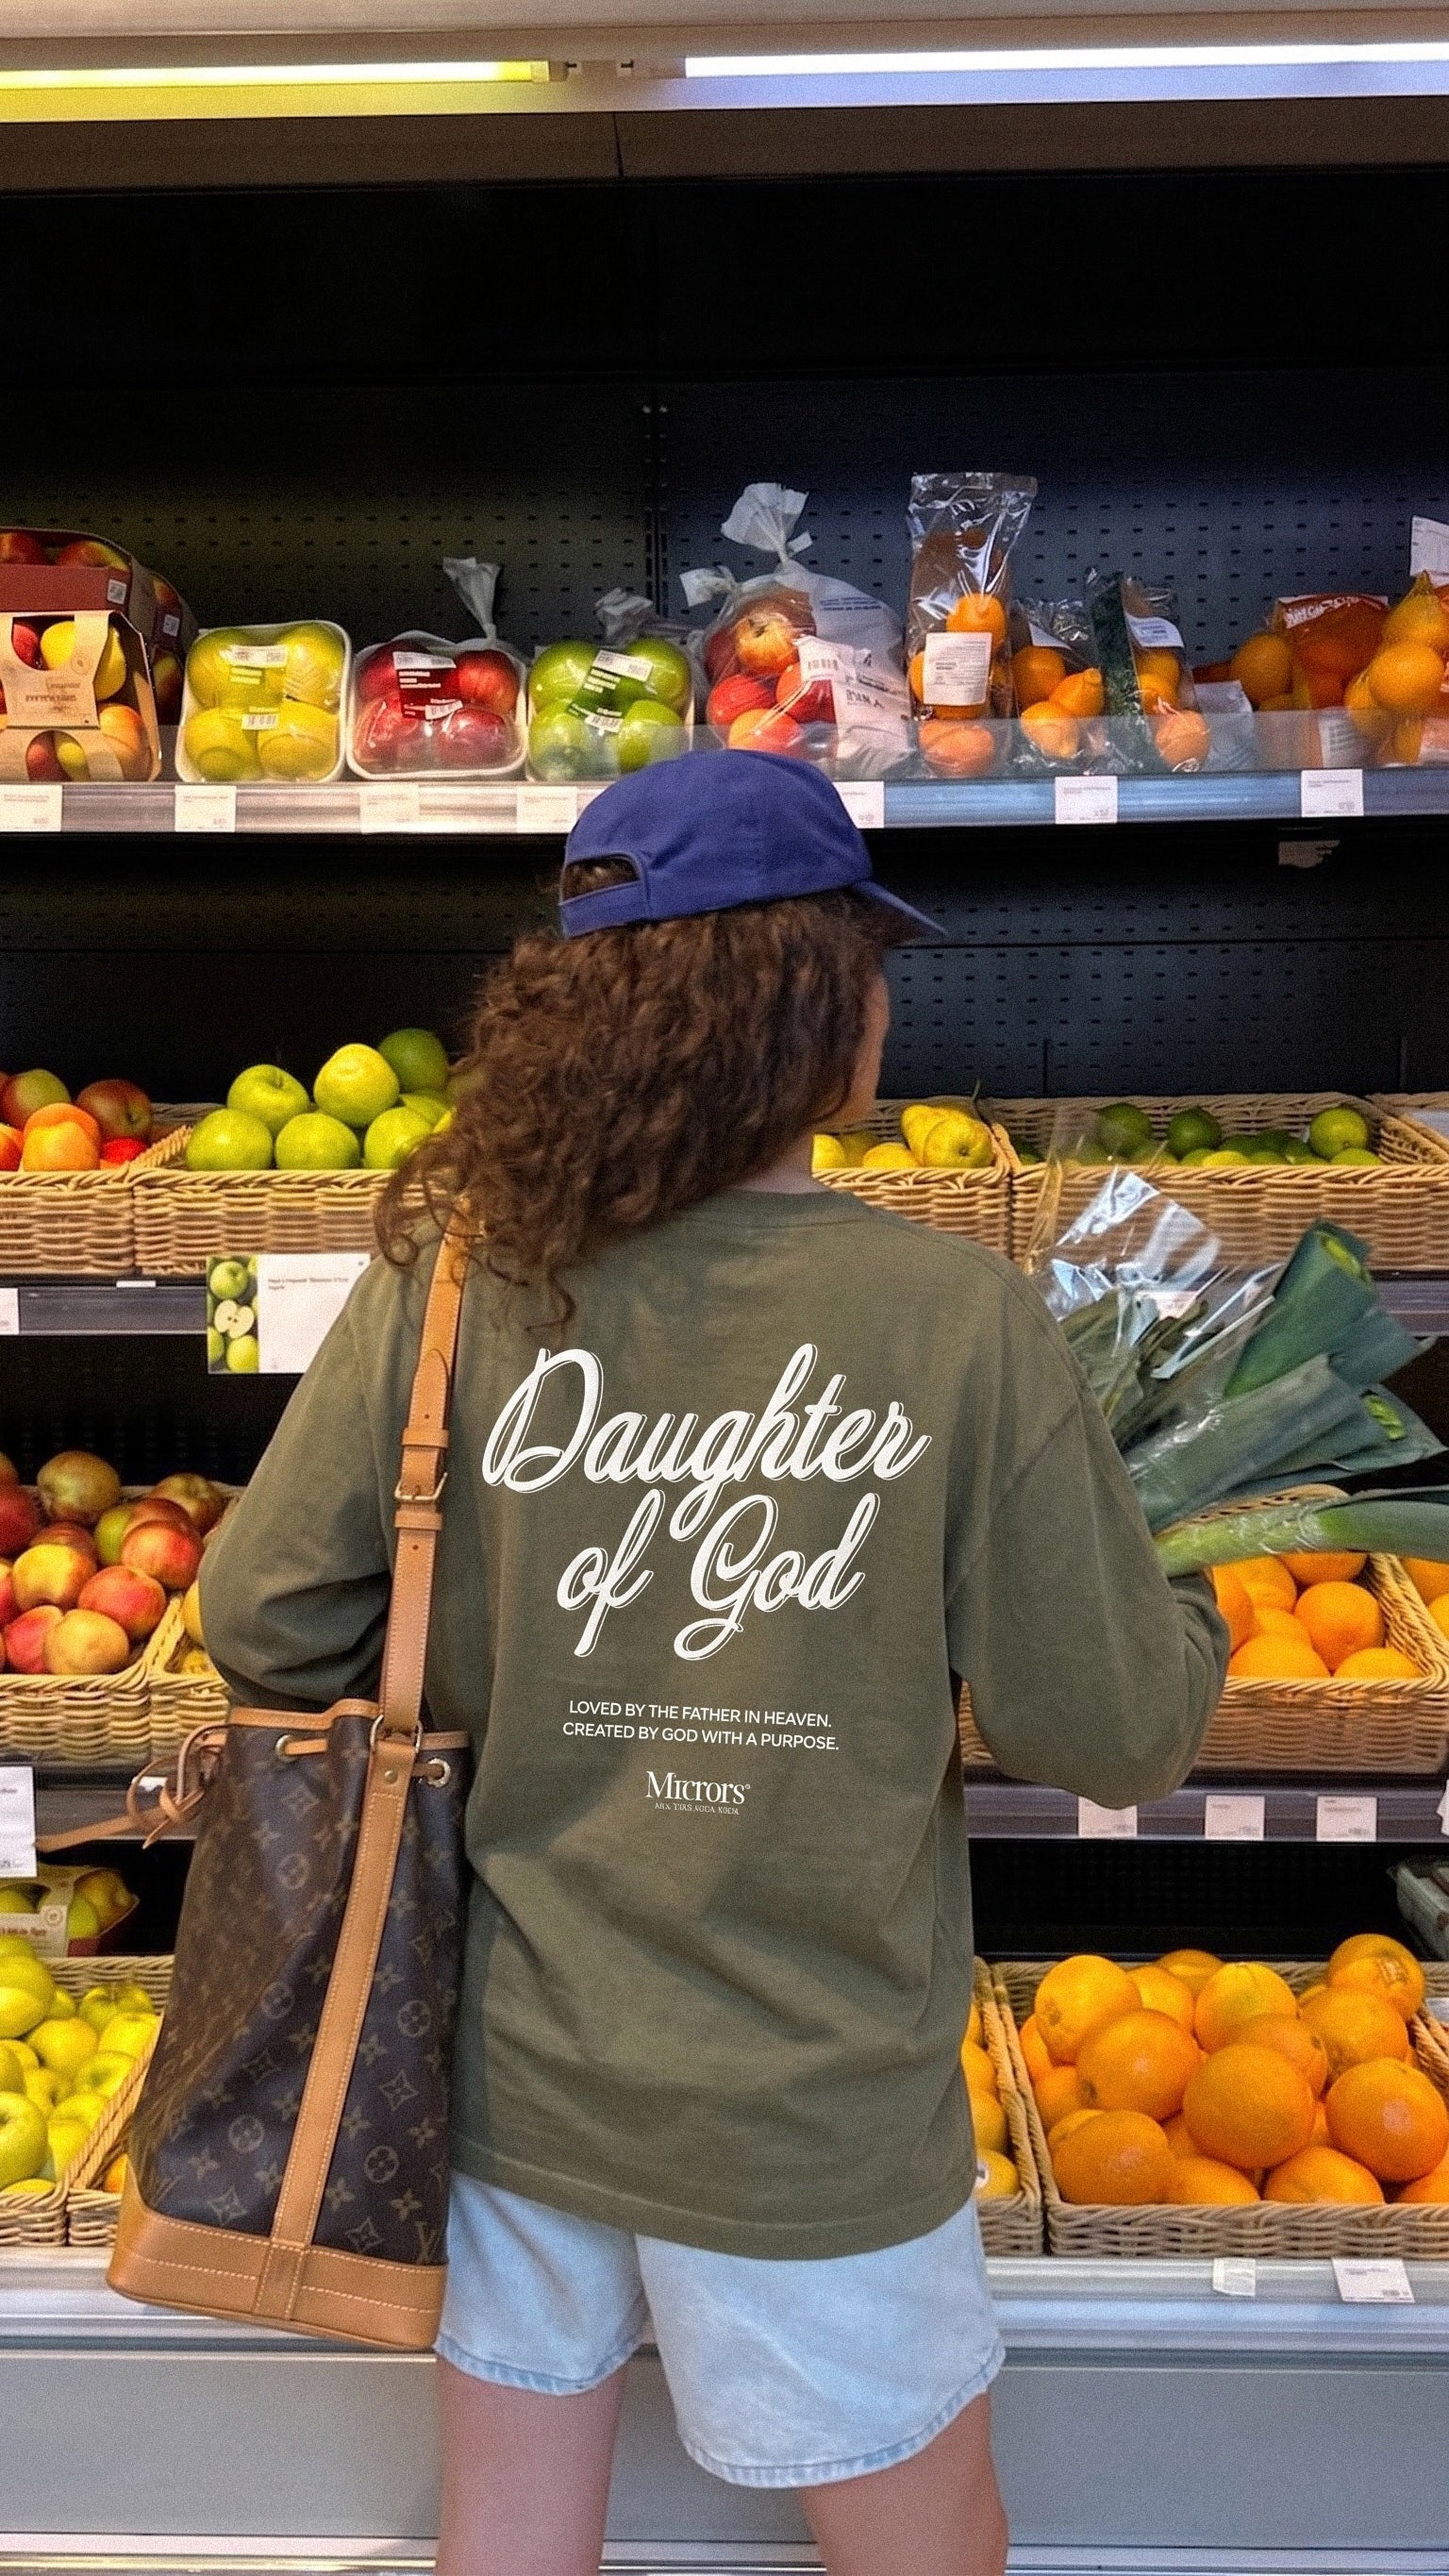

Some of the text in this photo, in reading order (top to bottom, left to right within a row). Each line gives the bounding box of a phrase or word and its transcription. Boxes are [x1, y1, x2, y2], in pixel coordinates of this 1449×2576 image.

[482, 1344, 932, 1542] Daughter
[558, 1489, 880, 1661] of God
[562, 1721, 840, 1751] CREATED BY GOD WITH A PURPOSE.
[569, 1699, 832, 1728] LOVED BY THE FATHER IN HEAVEN.
